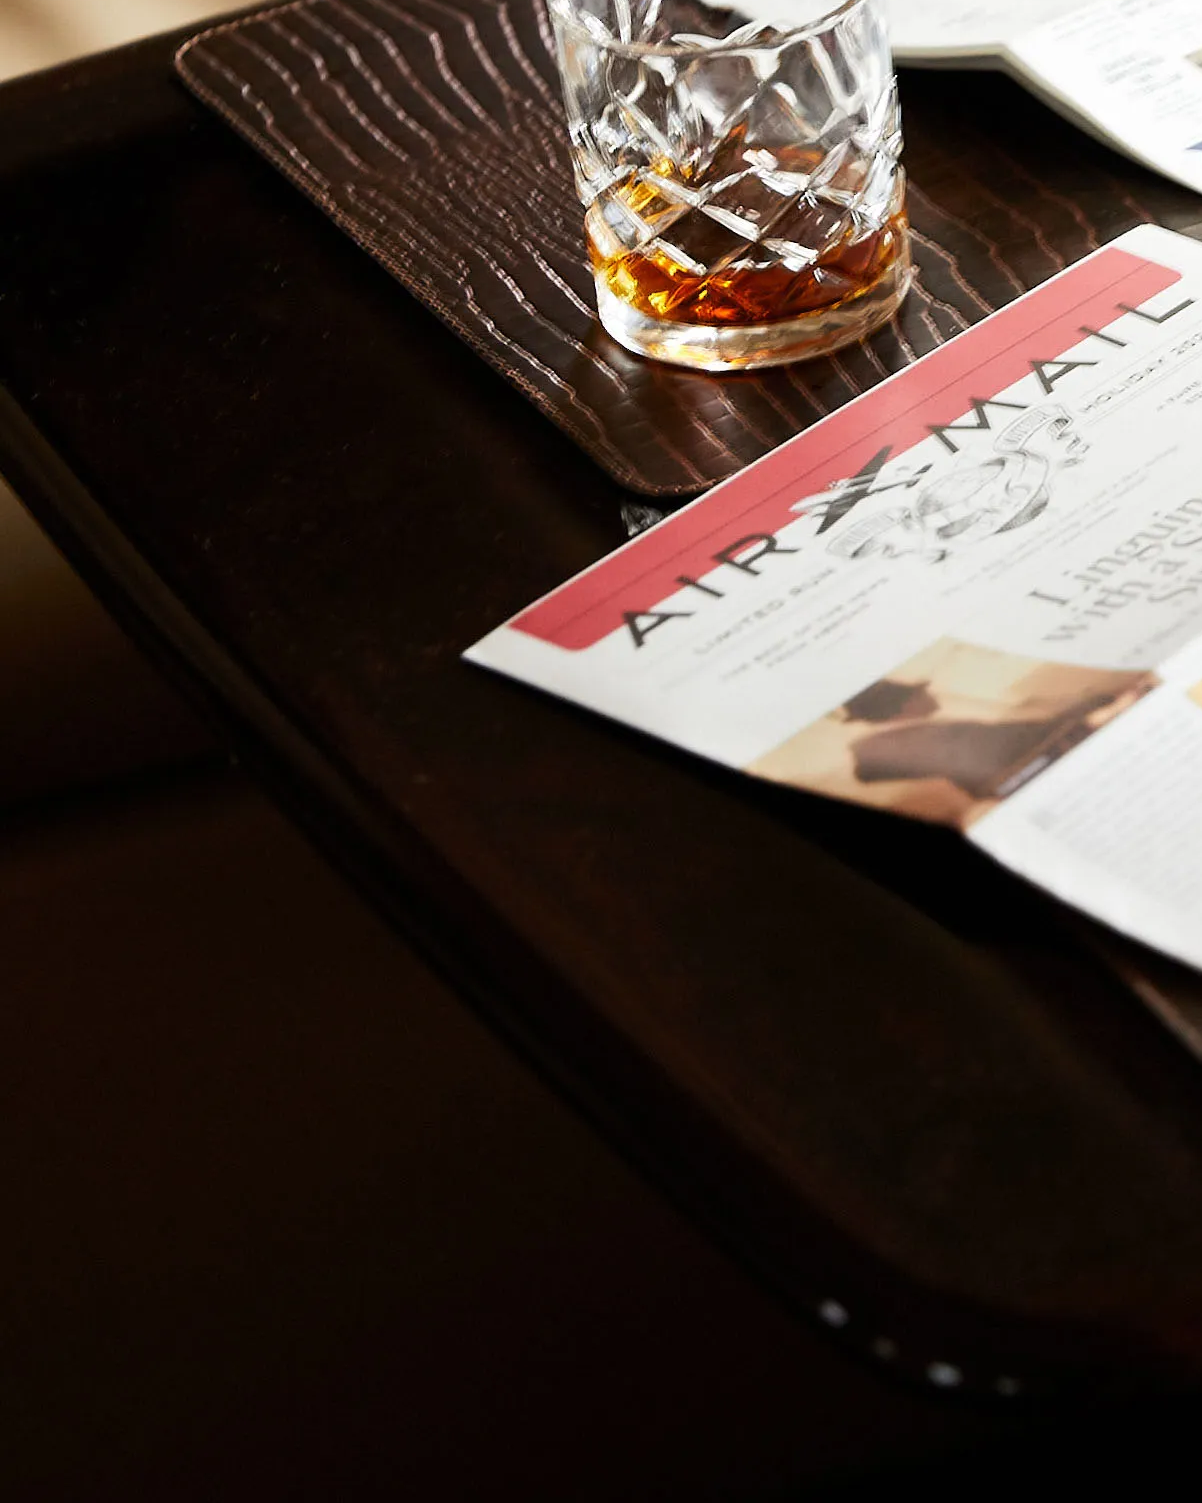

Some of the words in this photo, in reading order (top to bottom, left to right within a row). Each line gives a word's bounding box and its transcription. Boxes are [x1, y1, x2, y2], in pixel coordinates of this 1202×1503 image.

[622, 532, 803, 649] AIR
[921, 298, 1197, 452] MAIL
[1043, 585, 1152, 639] with
[1144, 555, 1189, 576] a
